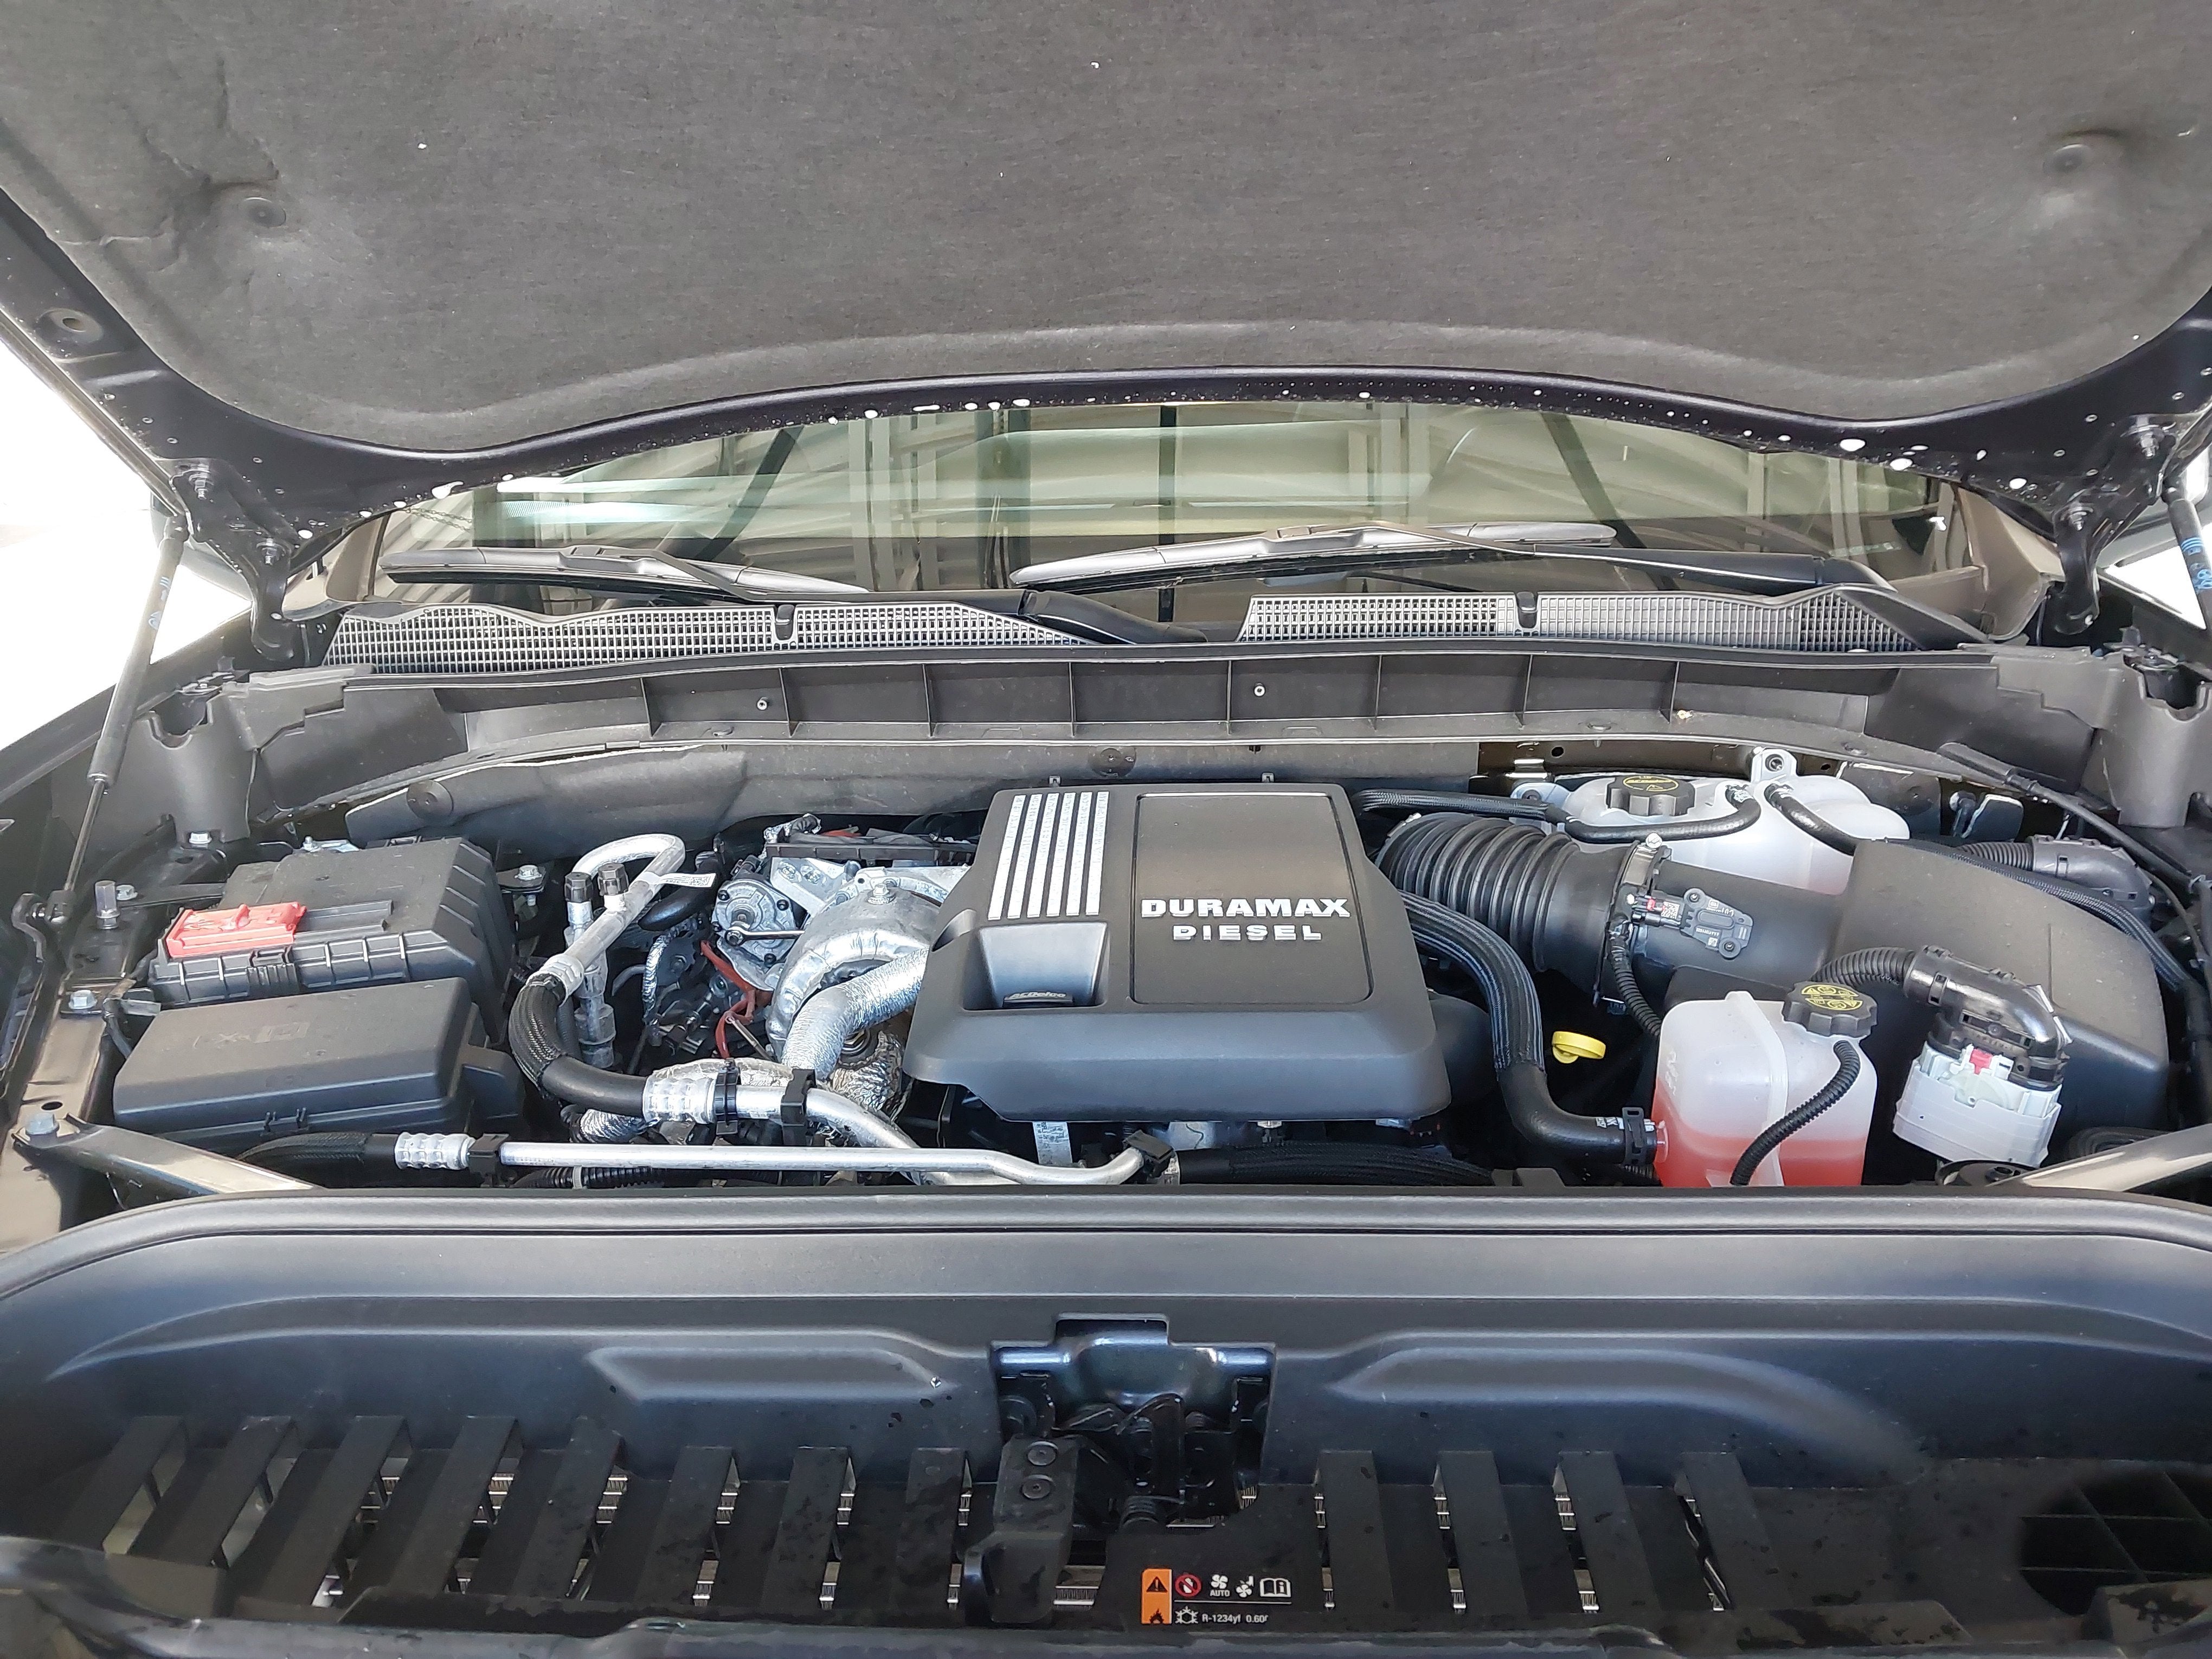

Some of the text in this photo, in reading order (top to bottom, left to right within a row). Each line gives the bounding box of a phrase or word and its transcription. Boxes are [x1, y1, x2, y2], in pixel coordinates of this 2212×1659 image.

[1141, 898, 1351, 917] DURAMAX
[1173, 924, 1322, 941] DIESEL
[1210, 1589, 1230, 1597] AUTO
